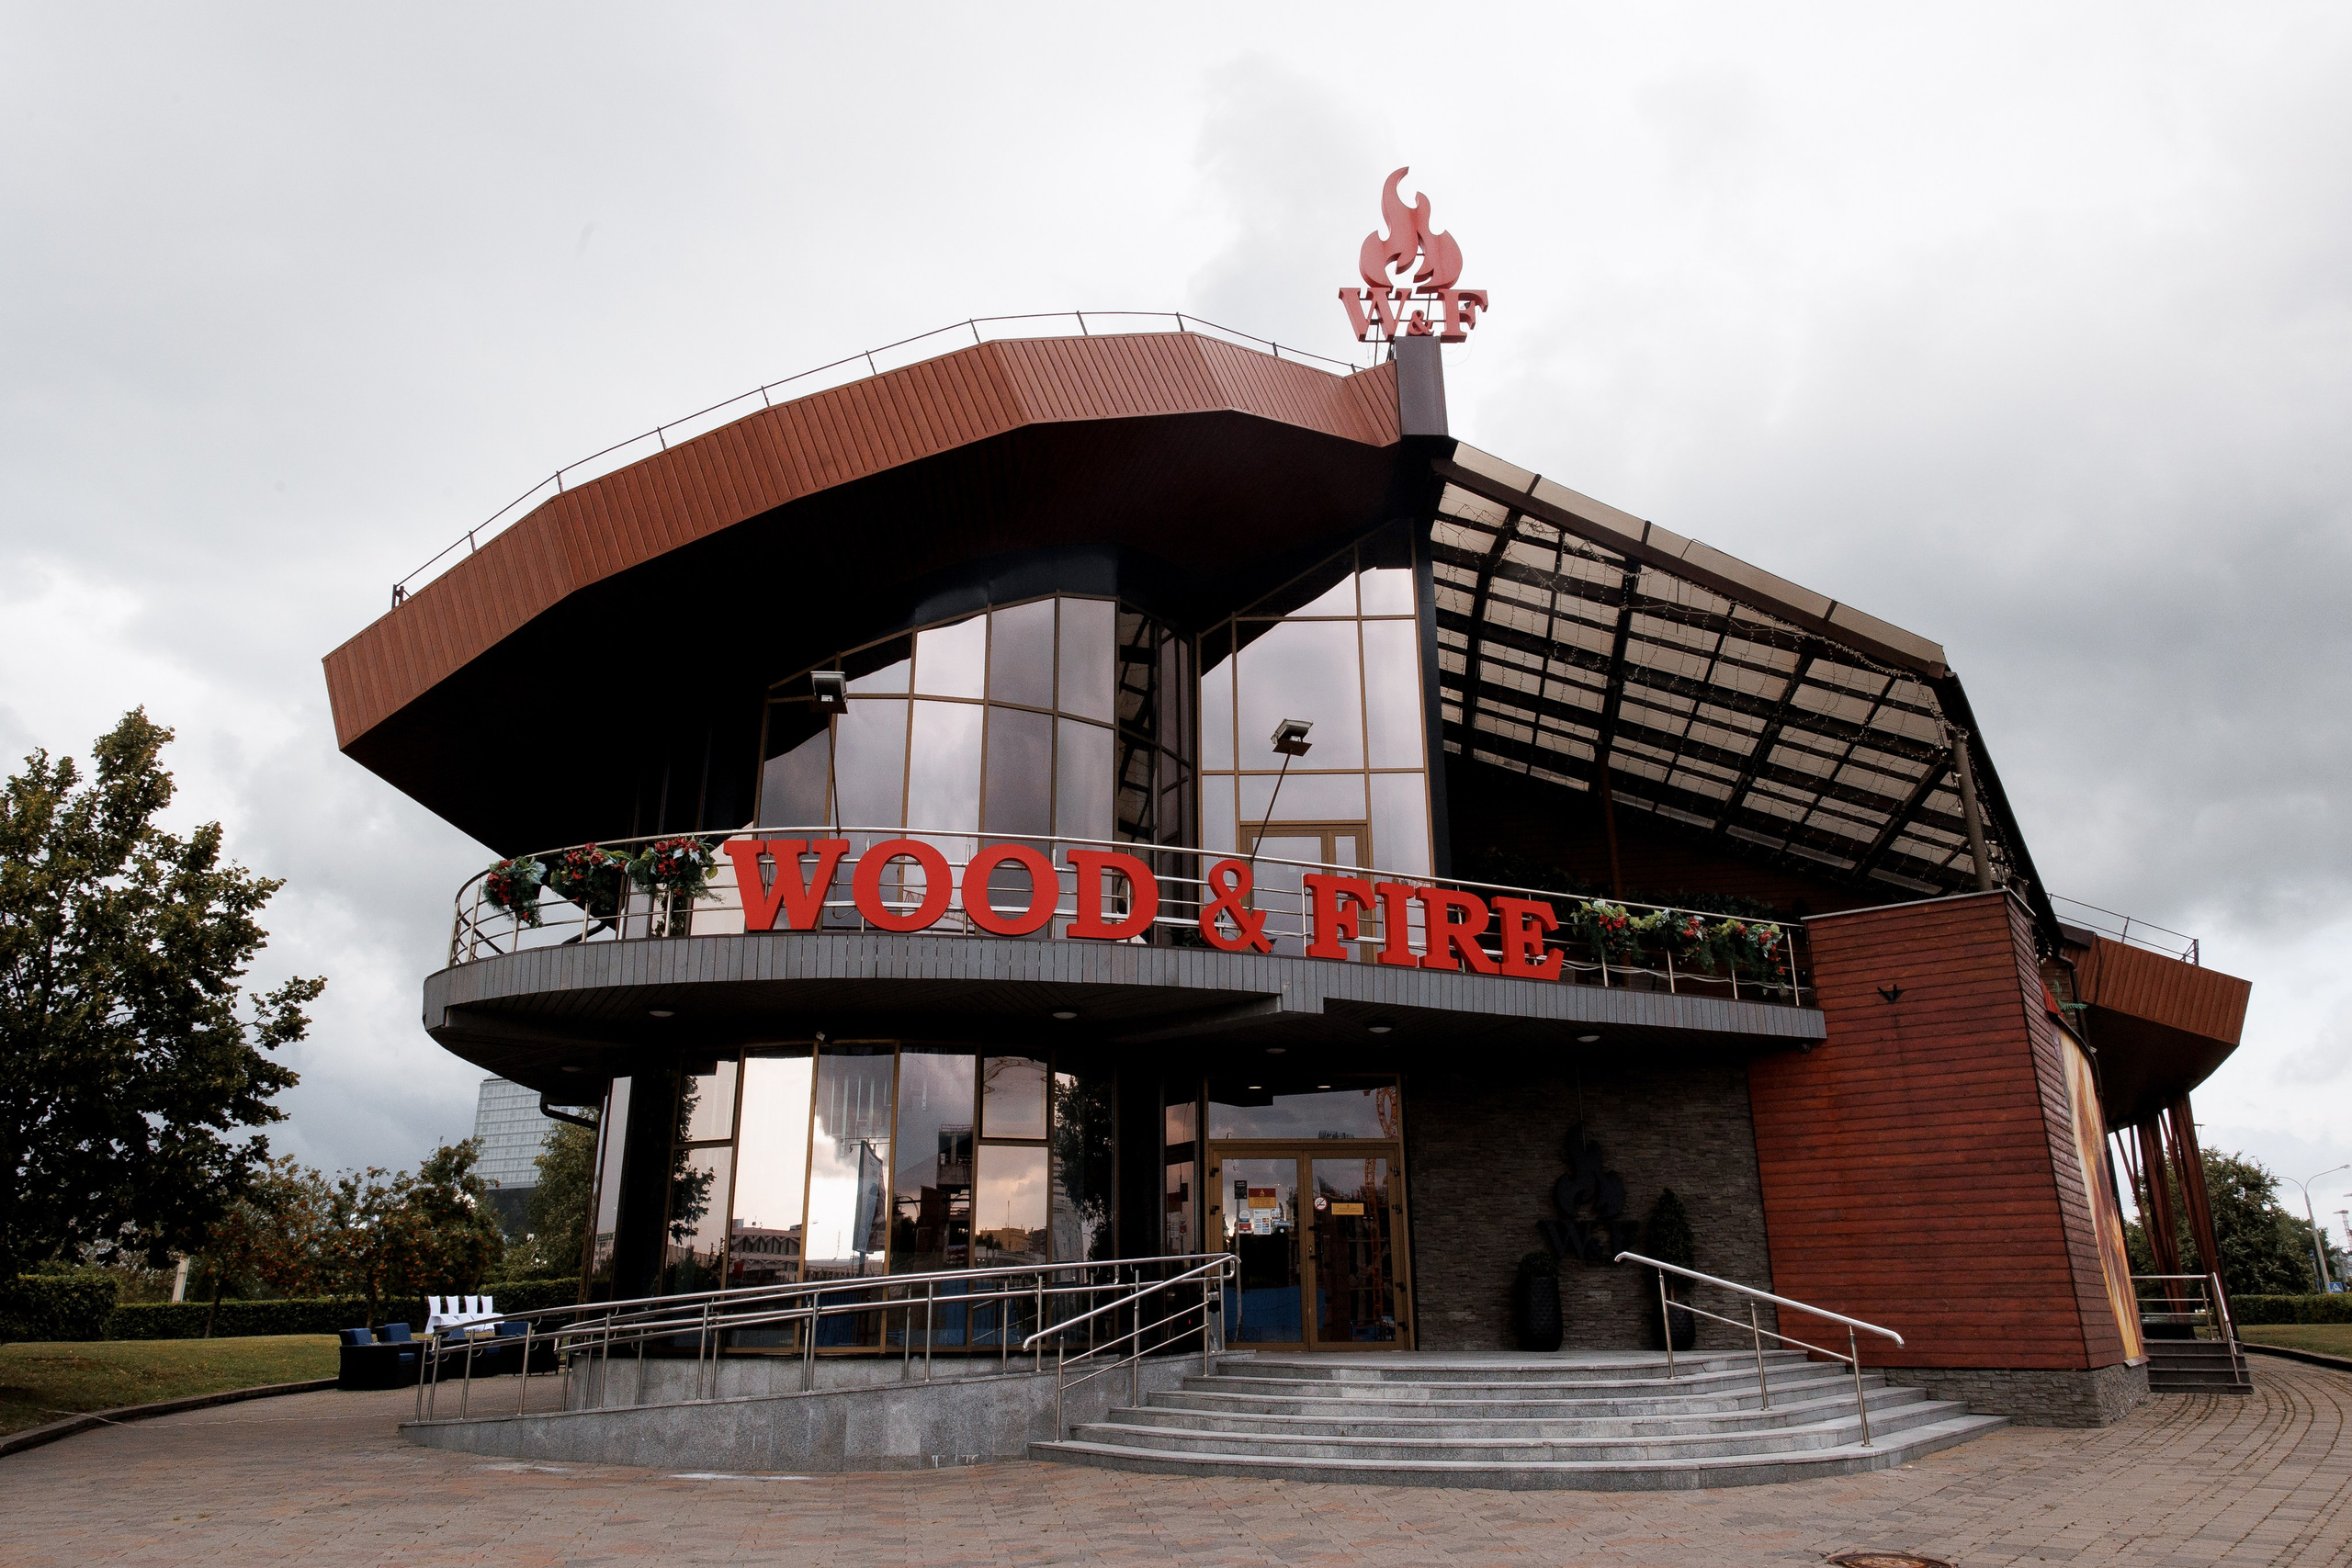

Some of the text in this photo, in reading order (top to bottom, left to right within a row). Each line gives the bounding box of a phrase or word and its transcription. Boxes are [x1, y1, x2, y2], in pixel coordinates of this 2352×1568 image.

[1339, 287, 1488, 343] W&F
[724, 839, 1565, 981] WOOD & FIRE
